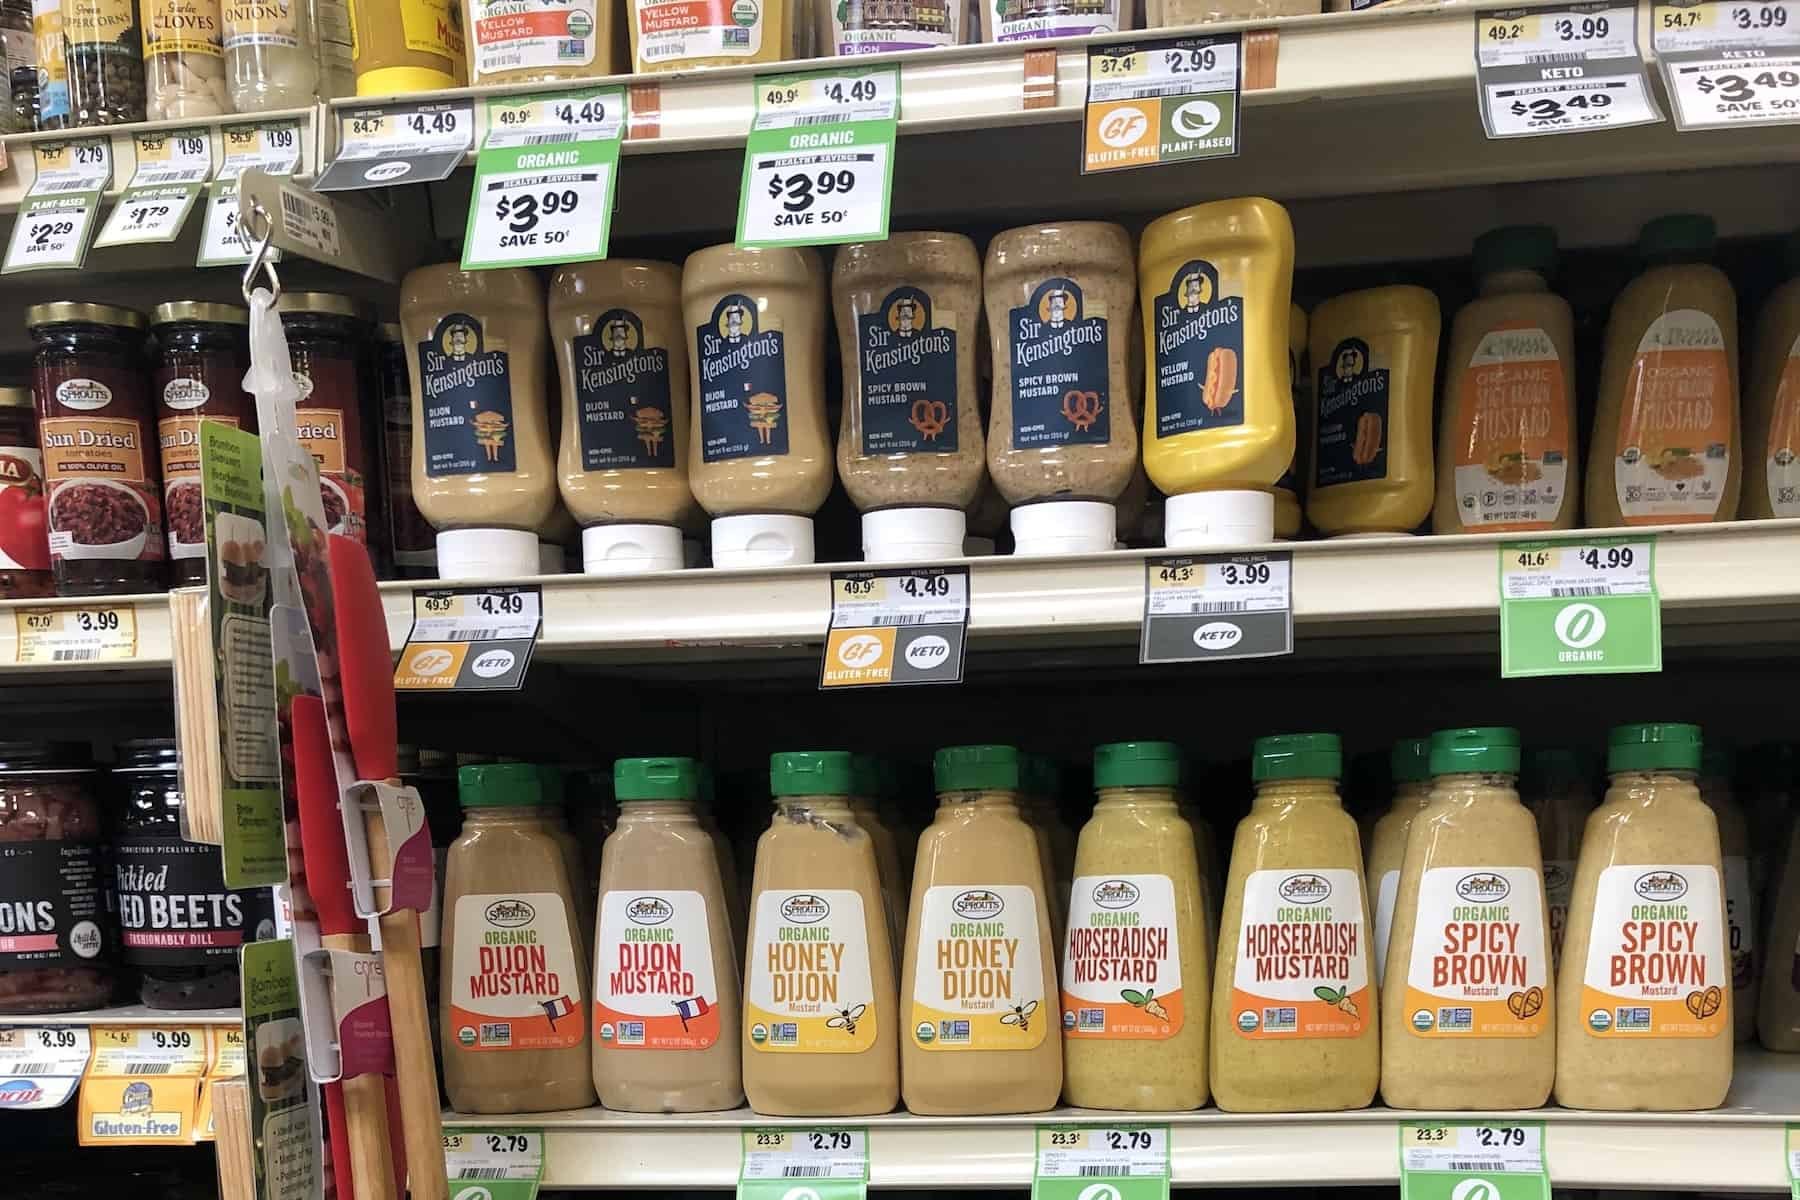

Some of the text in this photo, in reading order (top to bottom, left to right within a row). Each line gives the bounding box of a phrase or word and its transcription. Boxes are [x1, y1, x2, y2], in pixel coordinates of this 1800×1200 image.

[645, 4, 690, 19] YELLOW
[1733, 7, 1788, 29] $3.99
[645, 16, 699, 28] MUSTARD
[1555, 18, 1609, 42] $3.99
[1165, 51, 1216, 73] $2.99
[1542, 67, 1583, 79] KETO
[555, 103, 605, 124] $4.49
[789, 130, 854, 148] ORGANIC
[1162, 137, 1232, 154] PLANT-BASED
[517, 151, 579, 168] ORGANIC
[1088, 147, 1158, 164] GLUTEN-FREE
[774, 214, 813, 226] SAVE
[500, 233, 538, 247] SAVE
[1161, 307, 1181, 329] Sir
[869, 325, 890, 349] Sir
[1019, 318, 1041, 341] Sir
[704, 333, 722, 357] Sir
[427, 350, 446, 371] Sir
[426, 352, 504, 397] Kensington's
[1019, 372, 1078, 388] SPICY BROWN
[868, 394, 907, 406] MUSTARD
[1019, 386, 1059, 398] MUSTARD
[706, 399, 738, 413] MUSTARD
[430, 415, 464, 428] MUSTARD
[1479, 407, 1550, 439] MUSTARD
[1641, 405, 1713, 431] MUSTARD
[45, 429, 135, 449] Sun Dried
[1580, 548, 1633, 570] $4.99
[1221, 564, 1270, 585] $3.99
[76, 611, 118, 630] $3.99
[1200, 629, 1237, 641] KETO
[910, 645, 945, 659] KETO
[1558, 650, 1604, 662] ORGANIC
[478, 656, 510, 672] KETO
[826, 667, 889, 681] GLUTEN-FREE
[151, 895, 243, 928] BEETS
[1090, 912, 1140, 926] ORGANIC
[1277, 906, 1332, 922] ORGANIC
[1453, 906, 1510, 921] ORGANIC
[1631, 905, 1688, 920] ORGANIC
[129, 931, 214, 946] FASHIONABLY DILL
[484, 930, 537, 944] ORGANIC
[624, 927, 674, 942] ORGANIC
[779, 926, 830, 941] ORGANIC
[950, 922, 1004, 938] ORGANIC
[1621, 921, 1698, 953] SPICY
[1246, 923, 1357, 958] HORSERADISH
[480, 945, 546, 974] DIJON
[619, 943, 682, 971] DIJON
[937, 939, 1018, 969] HONEY
[1256, 955, 1349, 981] MUSTARD
[1610, 954, 1705, 986] BROWN
[470, 971, 560, 998] MUSTARD
[610, 970, 694, 996] MUSTARD
[943, 969, 1011, 1000] DIJON
[1641, 985, 1677, 996] Mustard
[38, 1032, 76, 1047] $8.99
[152, 1032, 191, 1047] $9.99
